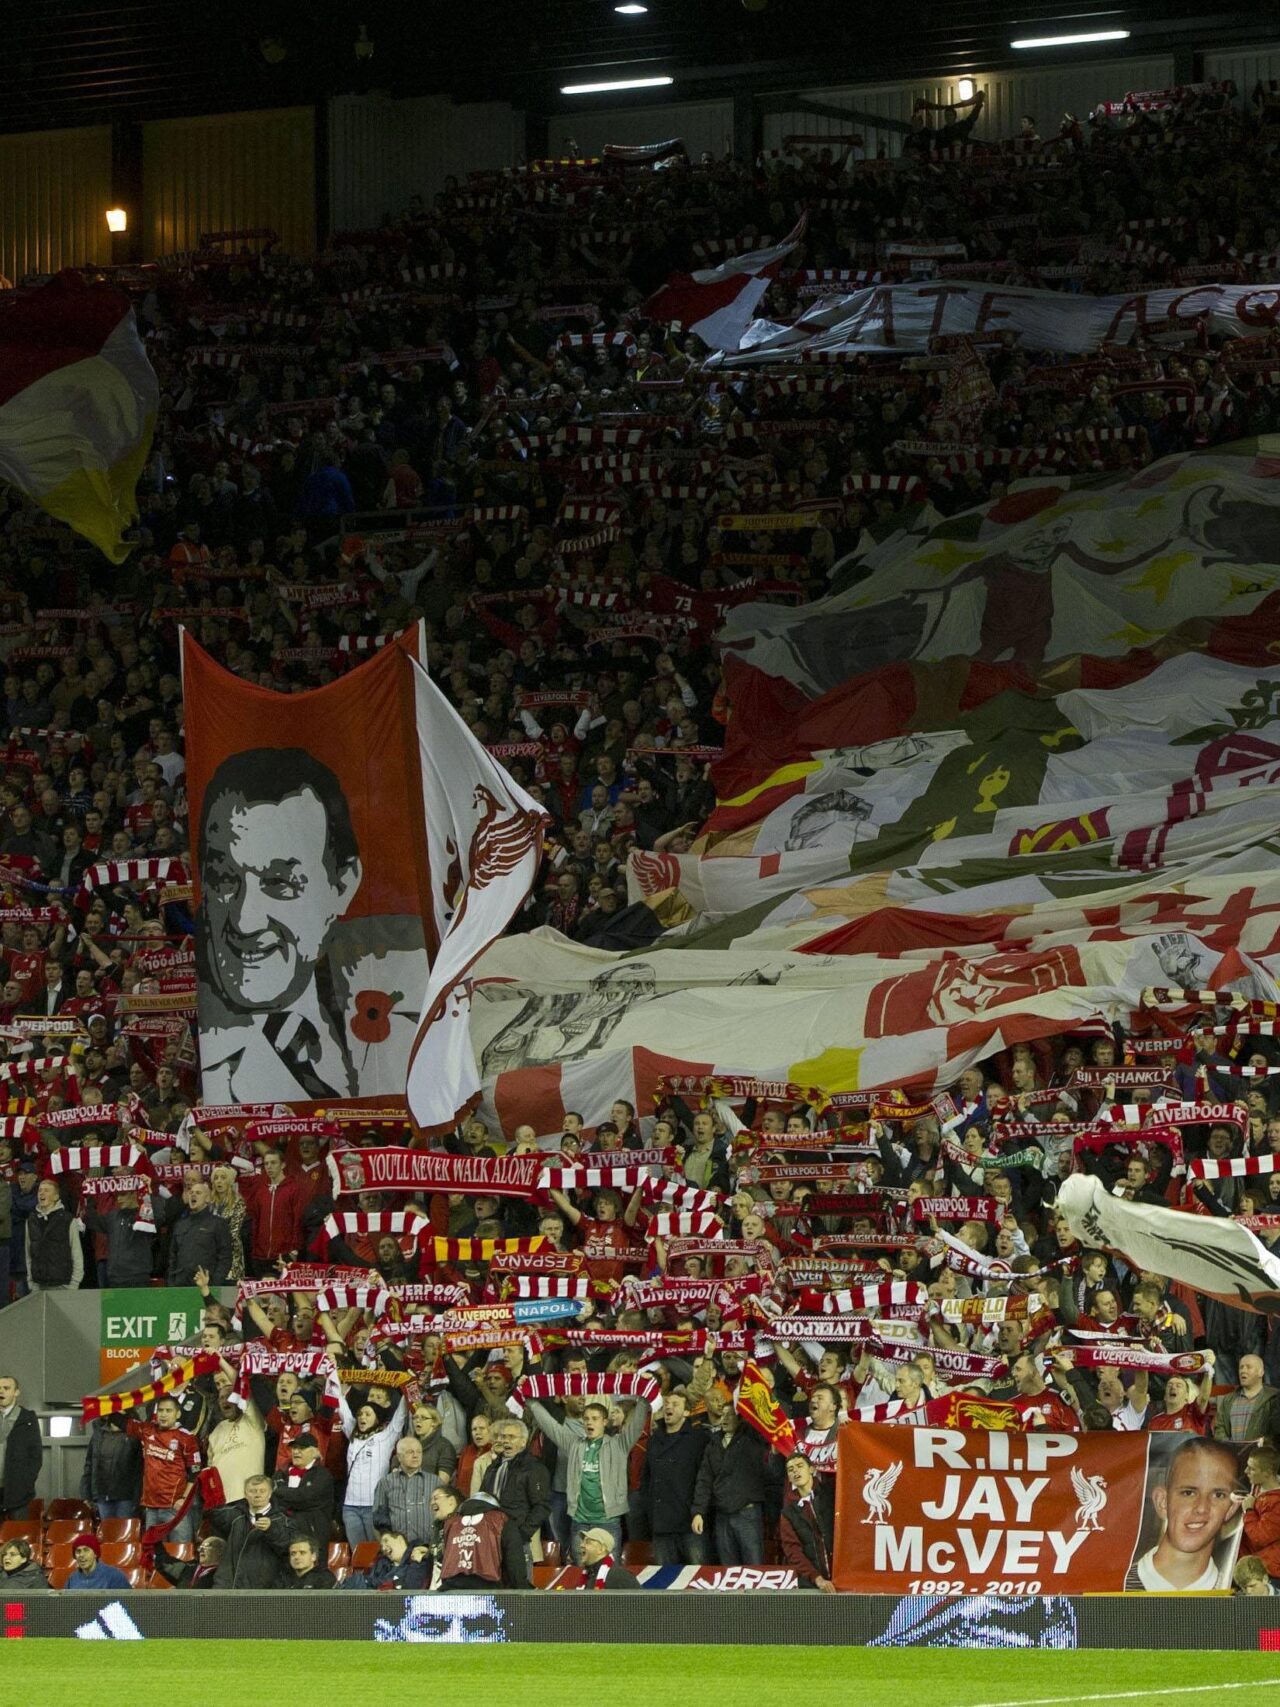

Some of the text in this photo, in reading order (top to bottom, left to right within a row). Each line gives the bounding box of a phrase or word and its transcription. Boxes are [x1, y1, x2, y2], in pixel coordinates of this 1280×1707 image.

[674, 595, 692, 610] 73
[1105, 1068, 1171, 1085] SHANKLY
[733, 1080, 788, 1098] LIVERPOOL
[46, 1106, 96, 1124] LIVERPOOL
[96, 1103, 114, 1117] FC
[197, 1105, 247, 1118] LIVERPOOL
[1153, 1103, 1246, 1123] LIVERPOOL FC
[257, 1122, 324, 1136] LIVERPOOL FC
[146, 1130, 164, 1146] THIS
[588, 1149, 668, 1168] LIVERPOOL
[368, 1153, 536, 1187] YOU'LL NEVER WALK ALONE
[775, 1165, 833, 1177] LIVERPOOL FC
[921, 1197, 989, 1213] LIVERPOOL FC
[828, 1233, 847, 1243] THE
[848, 1233, 881, 1244] MIGHTY
[254, 1279, 318, 1292] LIVERPOOL
[638, 1281, 714, 1304] Liverpool
[518, 1302, 576, 1317] NAPOLI
[943, 1298, 1005, 1314] ANFIELD
[457, 1308, 512, 1324] LIVERPOOL
[106, 1316, 158, 1338] EXIT
[770, 1320, 862, 1338] LIVERPOOL
[878, 1322, 920, 1344] EDS
[451, 1328, 524, 1348] LIVERPOOL
[731, 1330, 746, 1342] FC
[106, 1348, 140, 1360] BLOCK
[243, 1353, 310, 1374] LIVERPOOL
[913, 1428, 1079, 1472] R.I.P
[920, 1475, 1050, 1523] JAY
[452, 1533, 482, 1546] EUROPA
[873, 1525, 1091, 1575] McVEY
[907, 1580, 962, 1595] 1992
[986, 1580, 1042, 1595] 2010
